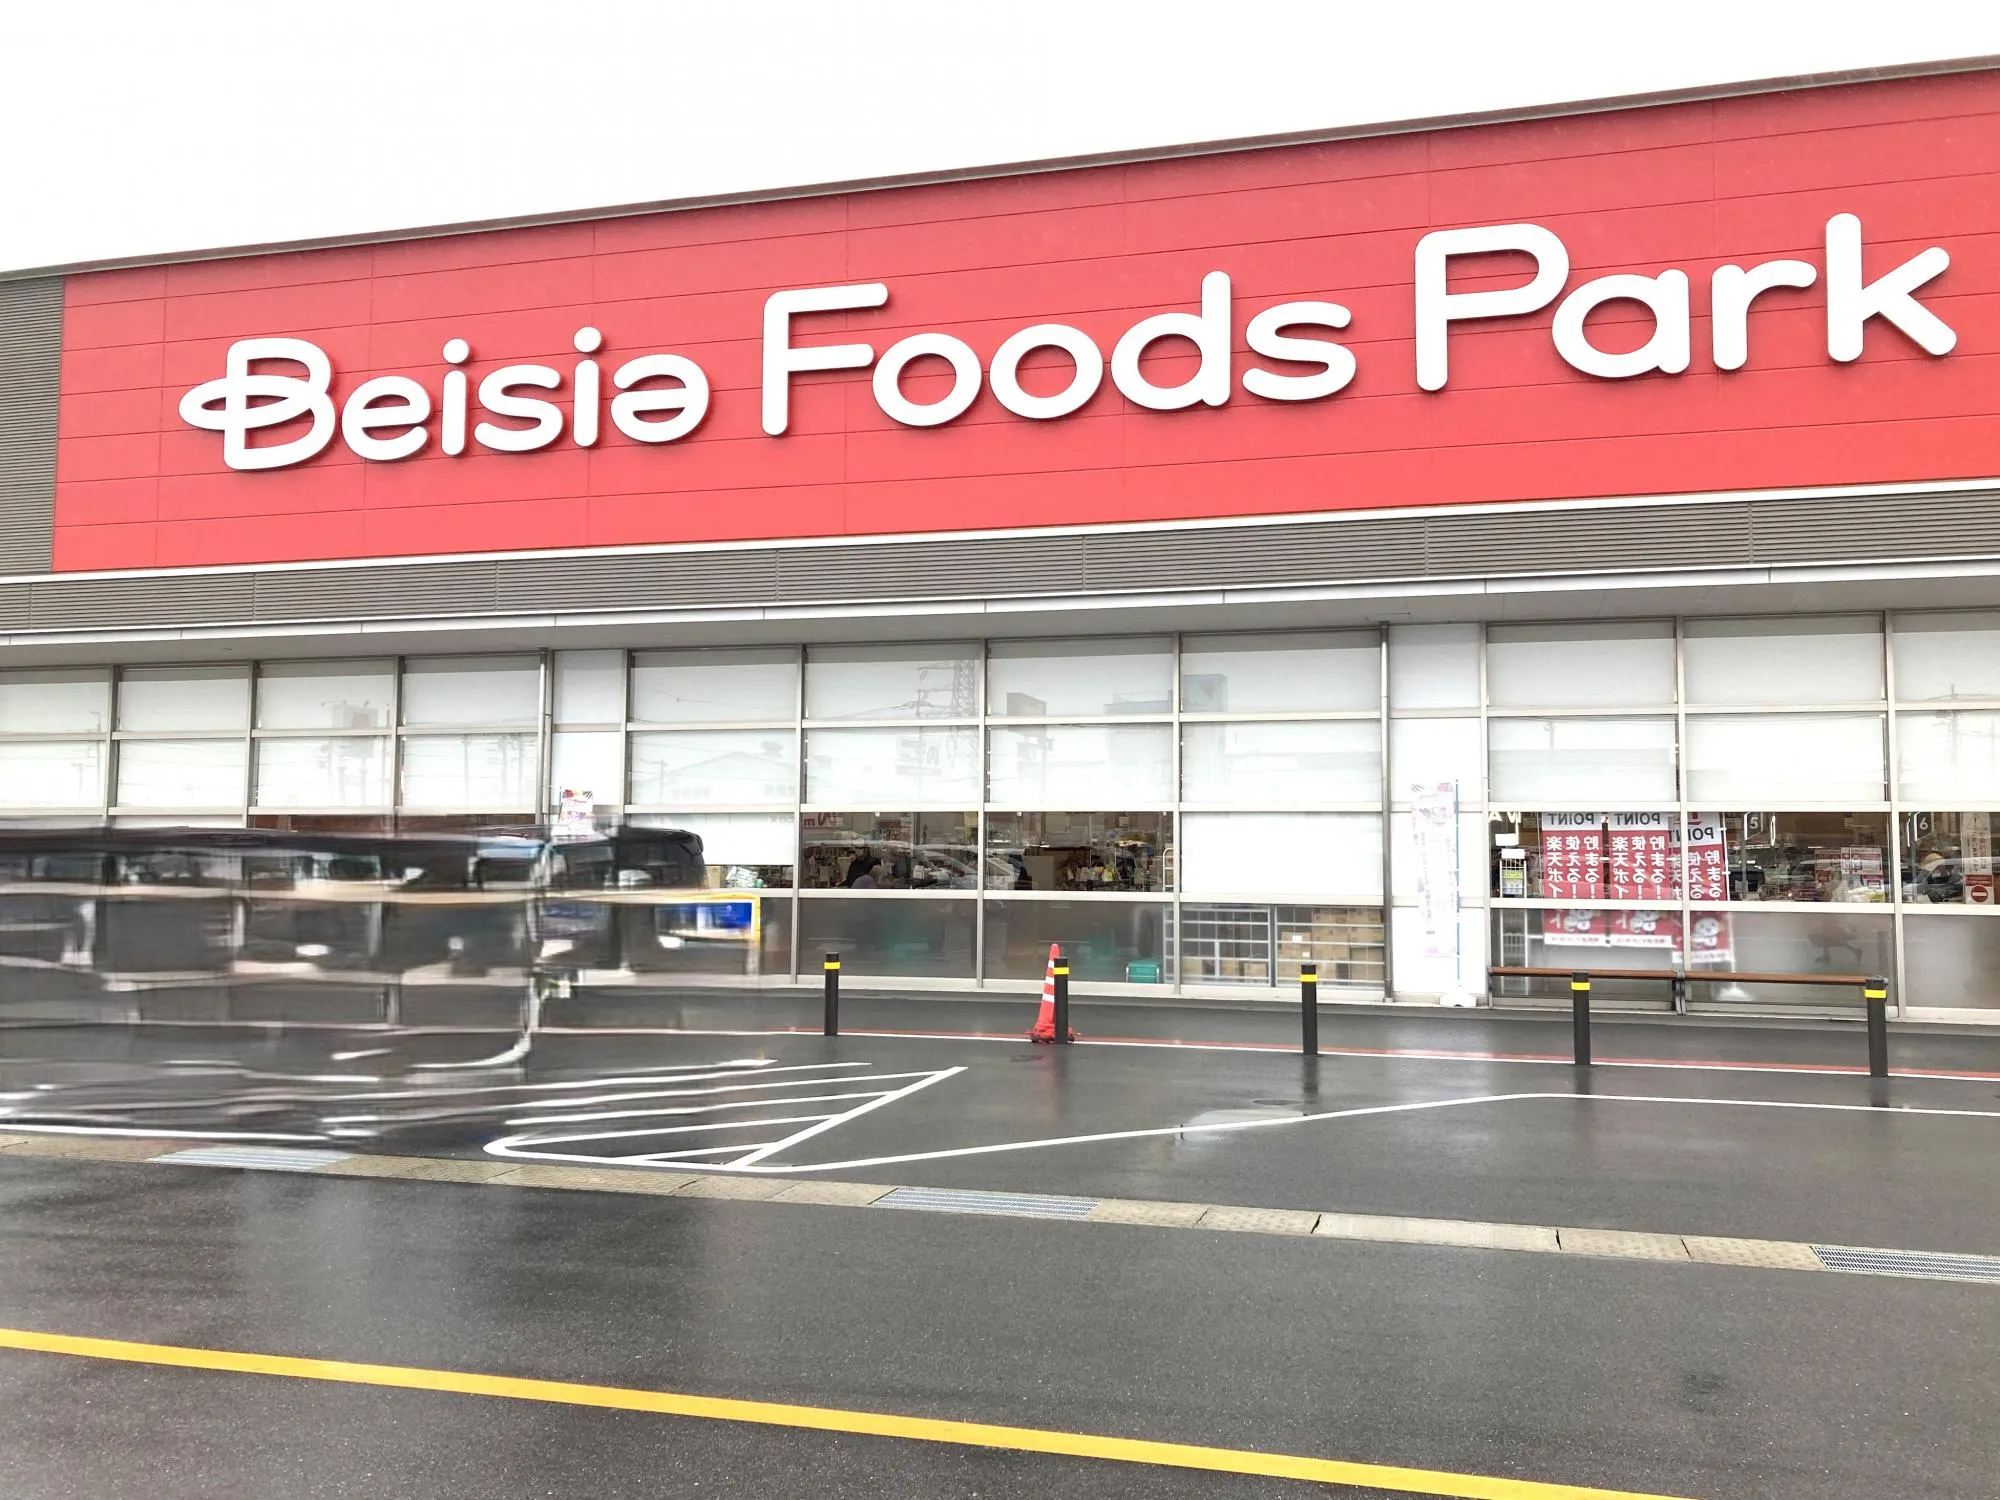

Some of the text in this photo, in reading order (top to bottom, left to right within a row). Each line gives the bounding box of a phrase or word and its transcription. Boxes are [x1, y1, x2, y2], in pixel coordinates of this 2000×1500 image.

[761, 271, 1357, 437] Foods
[1414, 213, 1957, 391] Park
[1750, 816, 1759, 829] 5
[1919, 817, 1929, 830] 6
